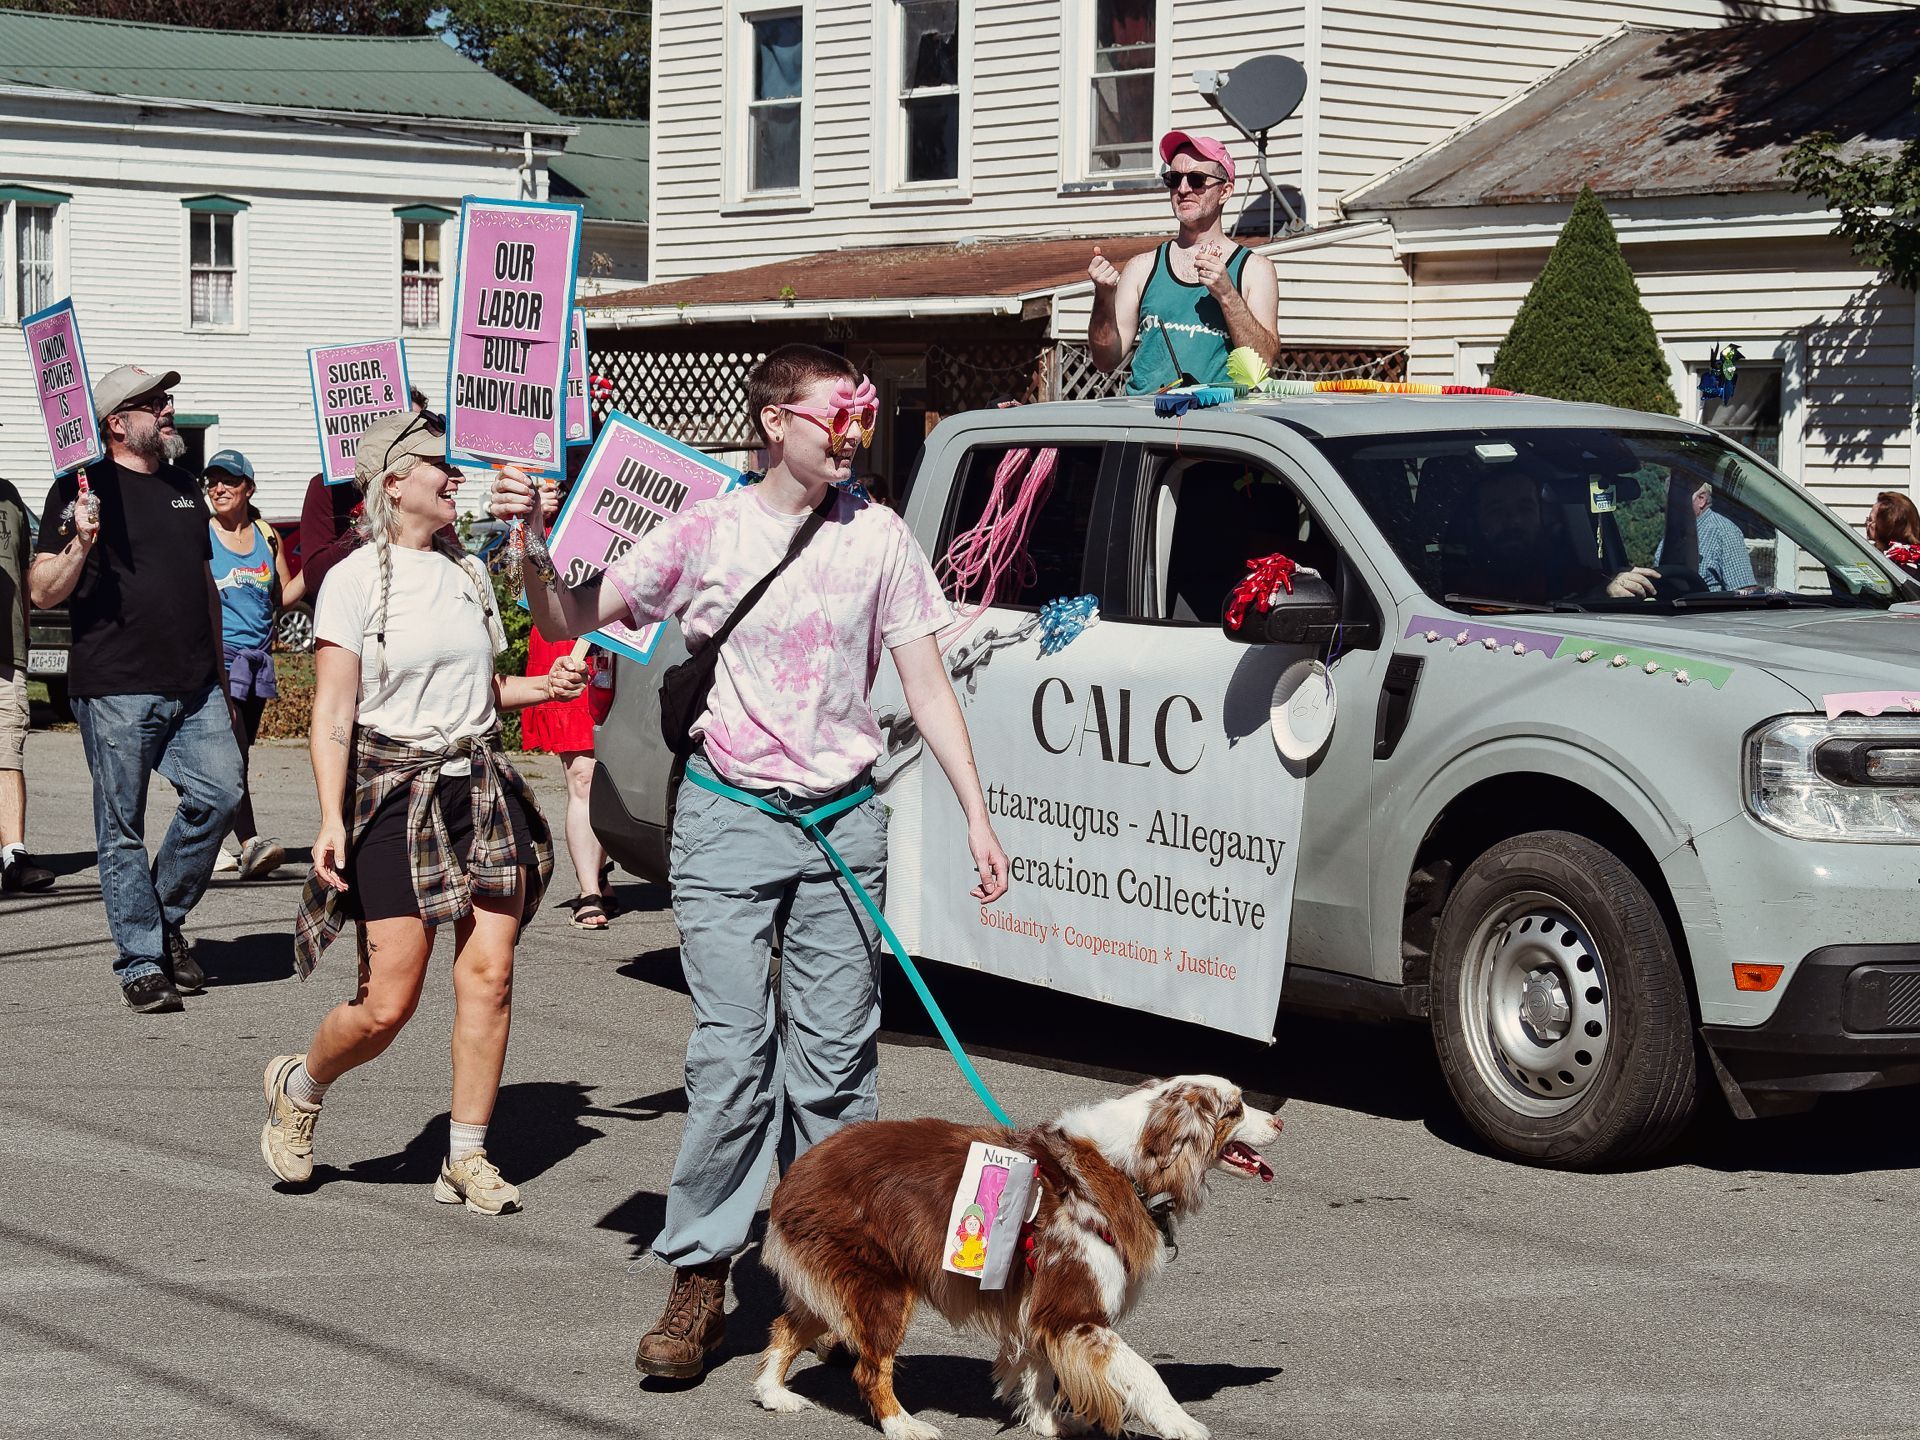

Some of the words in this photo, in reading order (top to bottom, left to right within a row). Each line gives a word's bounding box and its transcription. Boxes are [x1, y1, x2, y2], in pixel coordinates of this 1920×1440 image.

[495, 241, 535, 283] OUR
[477, 288, 543, 331] LABOR
[39, 333, 67, 363] UNION
[483, 336, 531, 375] BUILT
[42, 362, 75, 392] POWER
[328, 359, 387, 384] SUGAR,
[58, 393, 69, 417] IS
[327, 385, 378, 408] SPICE,
[383, 384, 394, 402] &
[456, 374, 553, 420] CANDYLAND
[55, 417, 84, 449] SWEET
[171, 496, 195, 508] cake
[616, 457, 689, 513] UNION
[1293, 688, 1321, 721] 64
[1032, 677, 1205, 774] CALC
[986, 782, 1119, 842] ttaraugus
[1146, 809, 1286, 876] Allegany
[974, 854, 1110, 900] eration
[1117, 867, 1266, 930] Collective
[980, 906, 1048, 944] Solidarity
[1064, 925, 1158, 964] Cooperation
[1177, 950, 1237, 981] Justice
